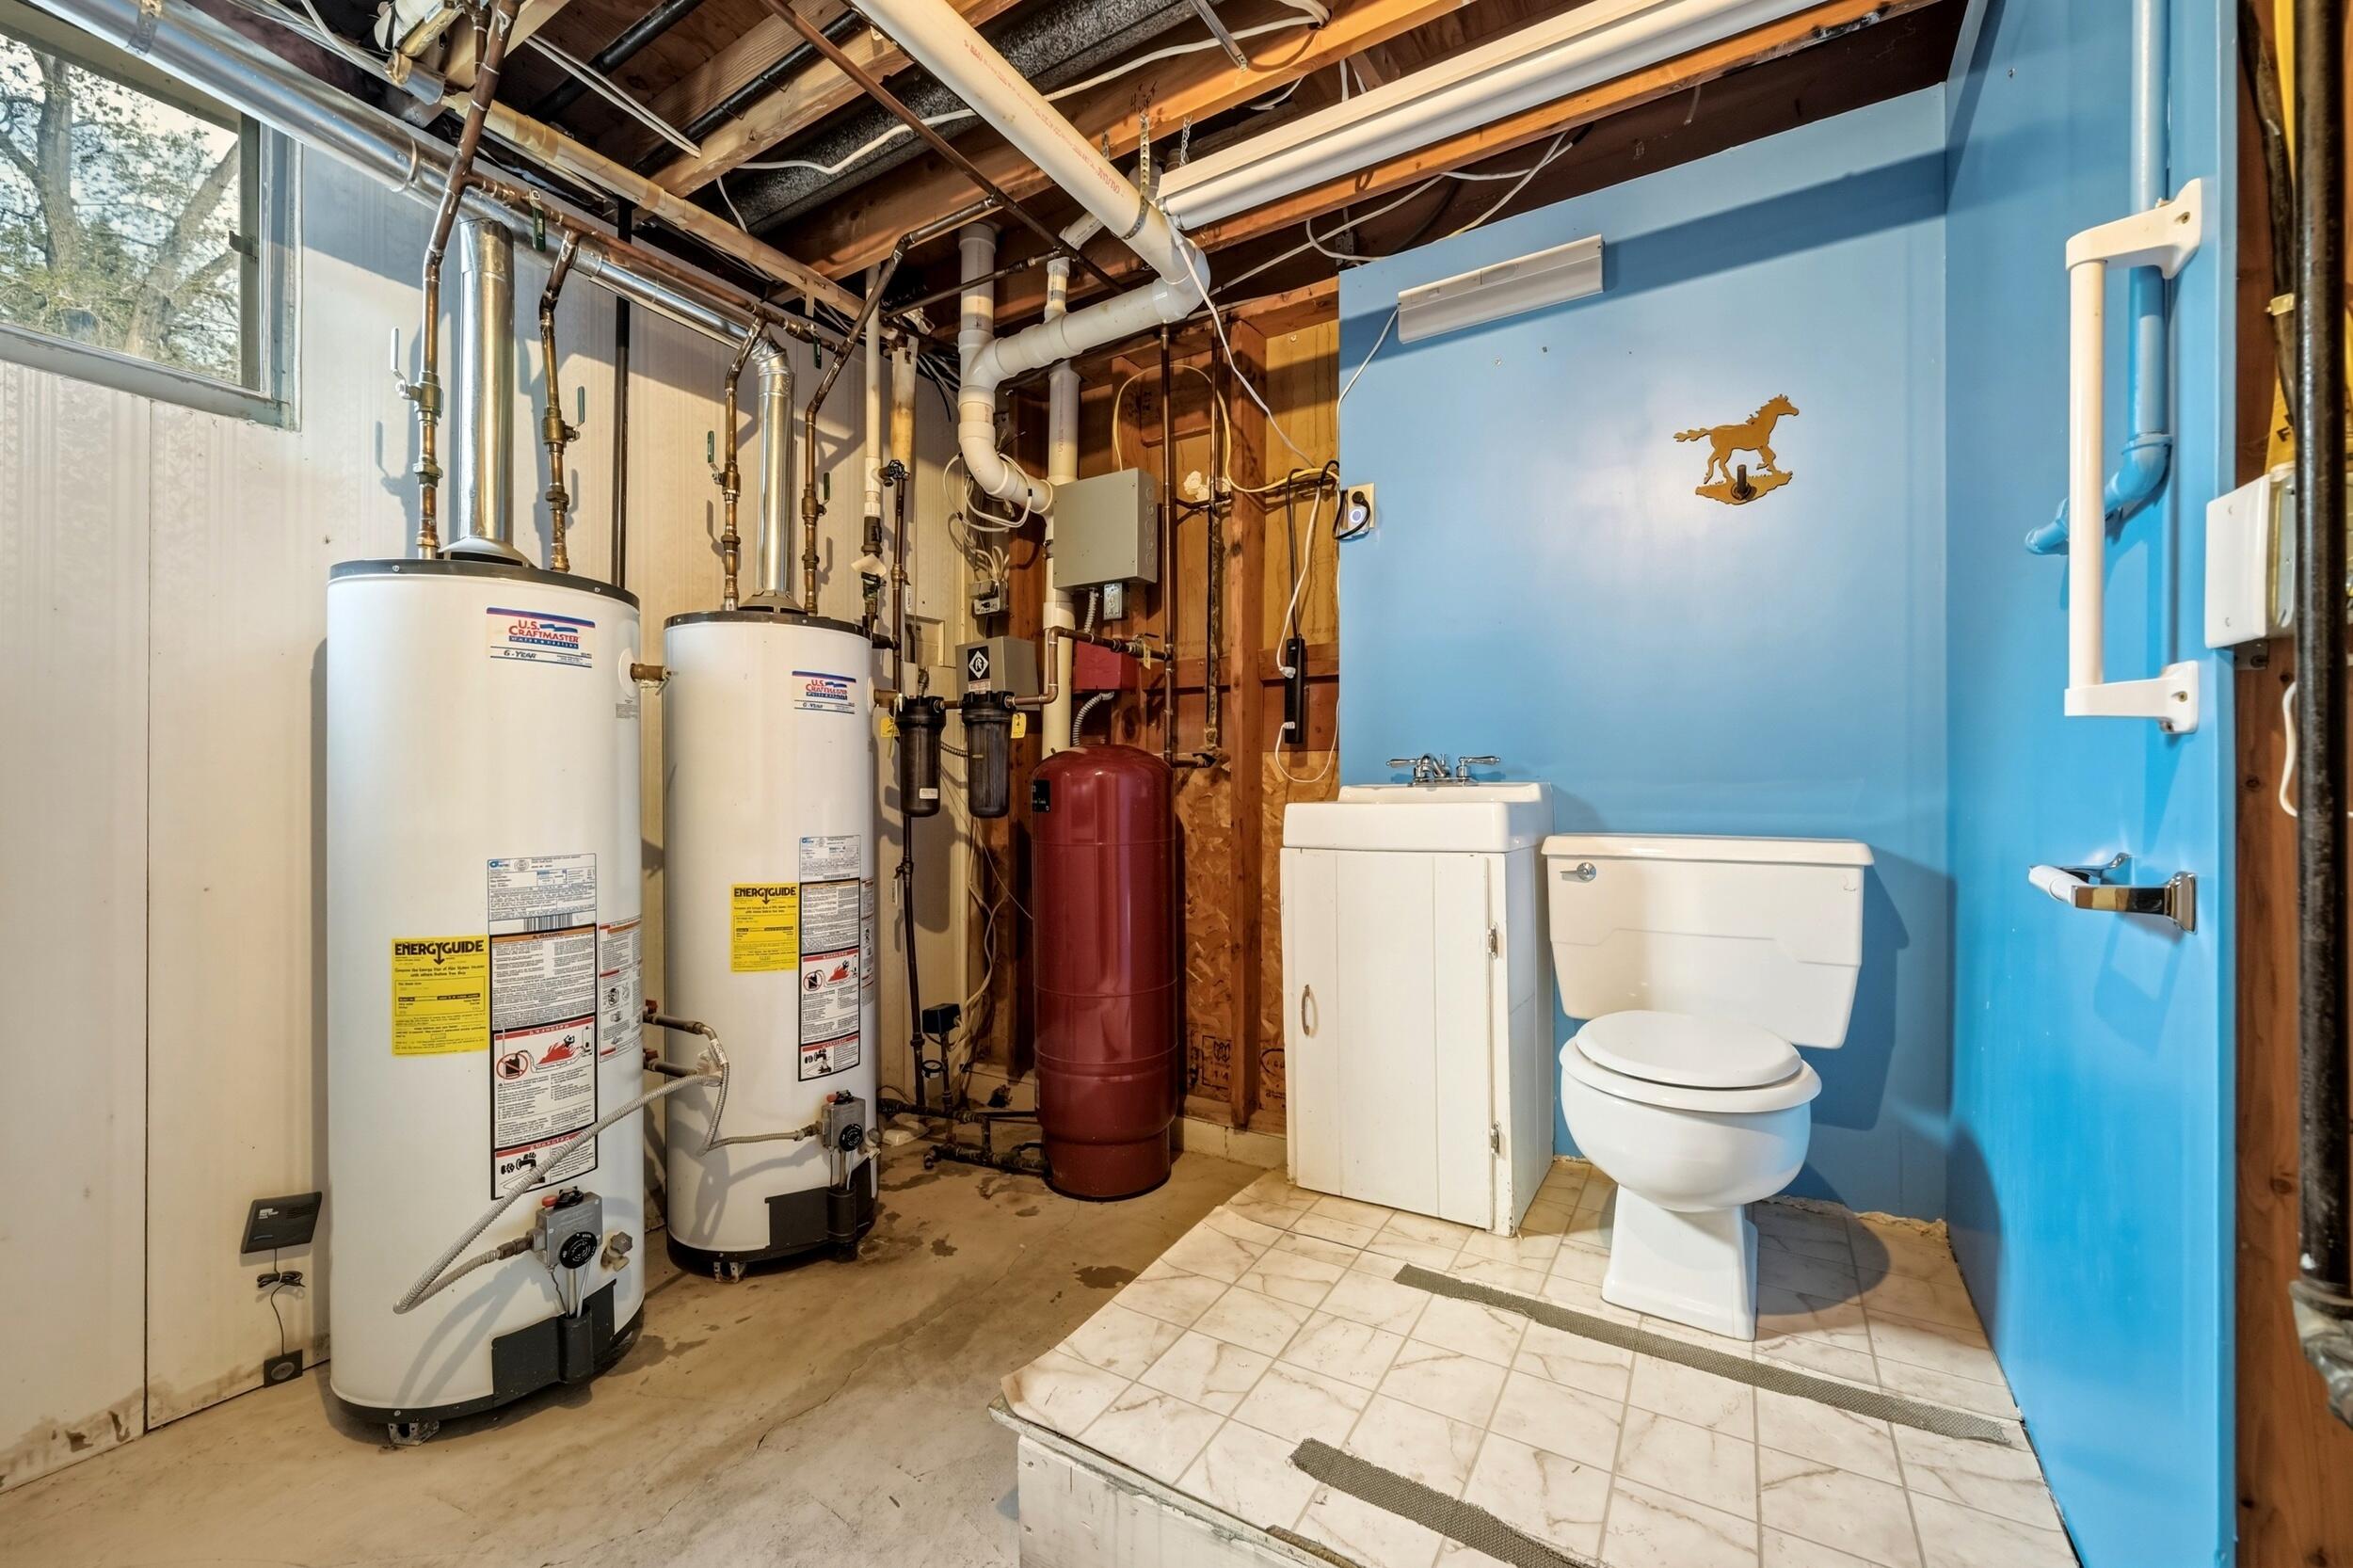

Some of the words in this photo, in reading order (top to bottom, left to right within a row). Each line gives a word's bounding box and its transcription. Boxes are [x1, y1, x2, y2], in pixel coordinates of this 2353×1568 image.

[519, 619, 540, 631] U.S.
[508, 625, 579, 644] CRAFTMASTER
[734, 887, 796, 899] ENERGYGUIDE
[395, 940, 485, 957] ENERGYGUIDE
